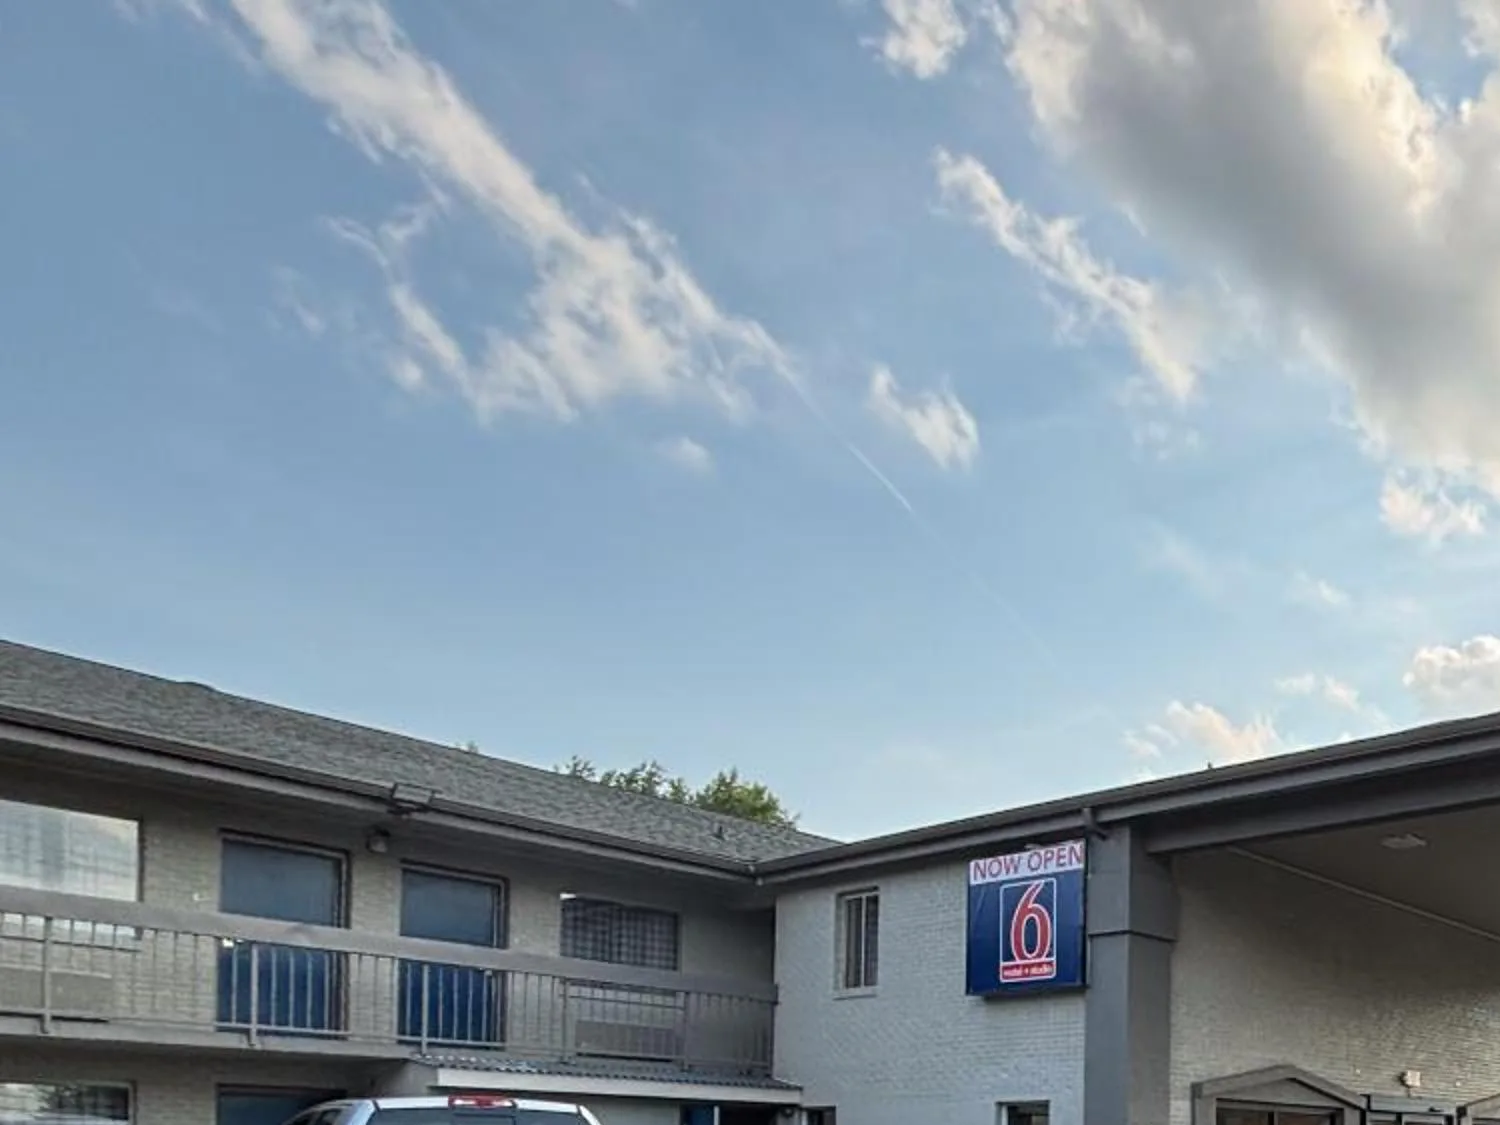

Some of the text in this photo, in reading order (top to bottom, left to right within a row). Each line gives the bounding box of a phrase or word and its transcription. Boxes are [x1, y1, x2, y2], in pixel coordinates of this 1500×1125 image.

[973, 845, 1082, 880] NOW OPEN
[1011, 880, 1051, 961] 6
